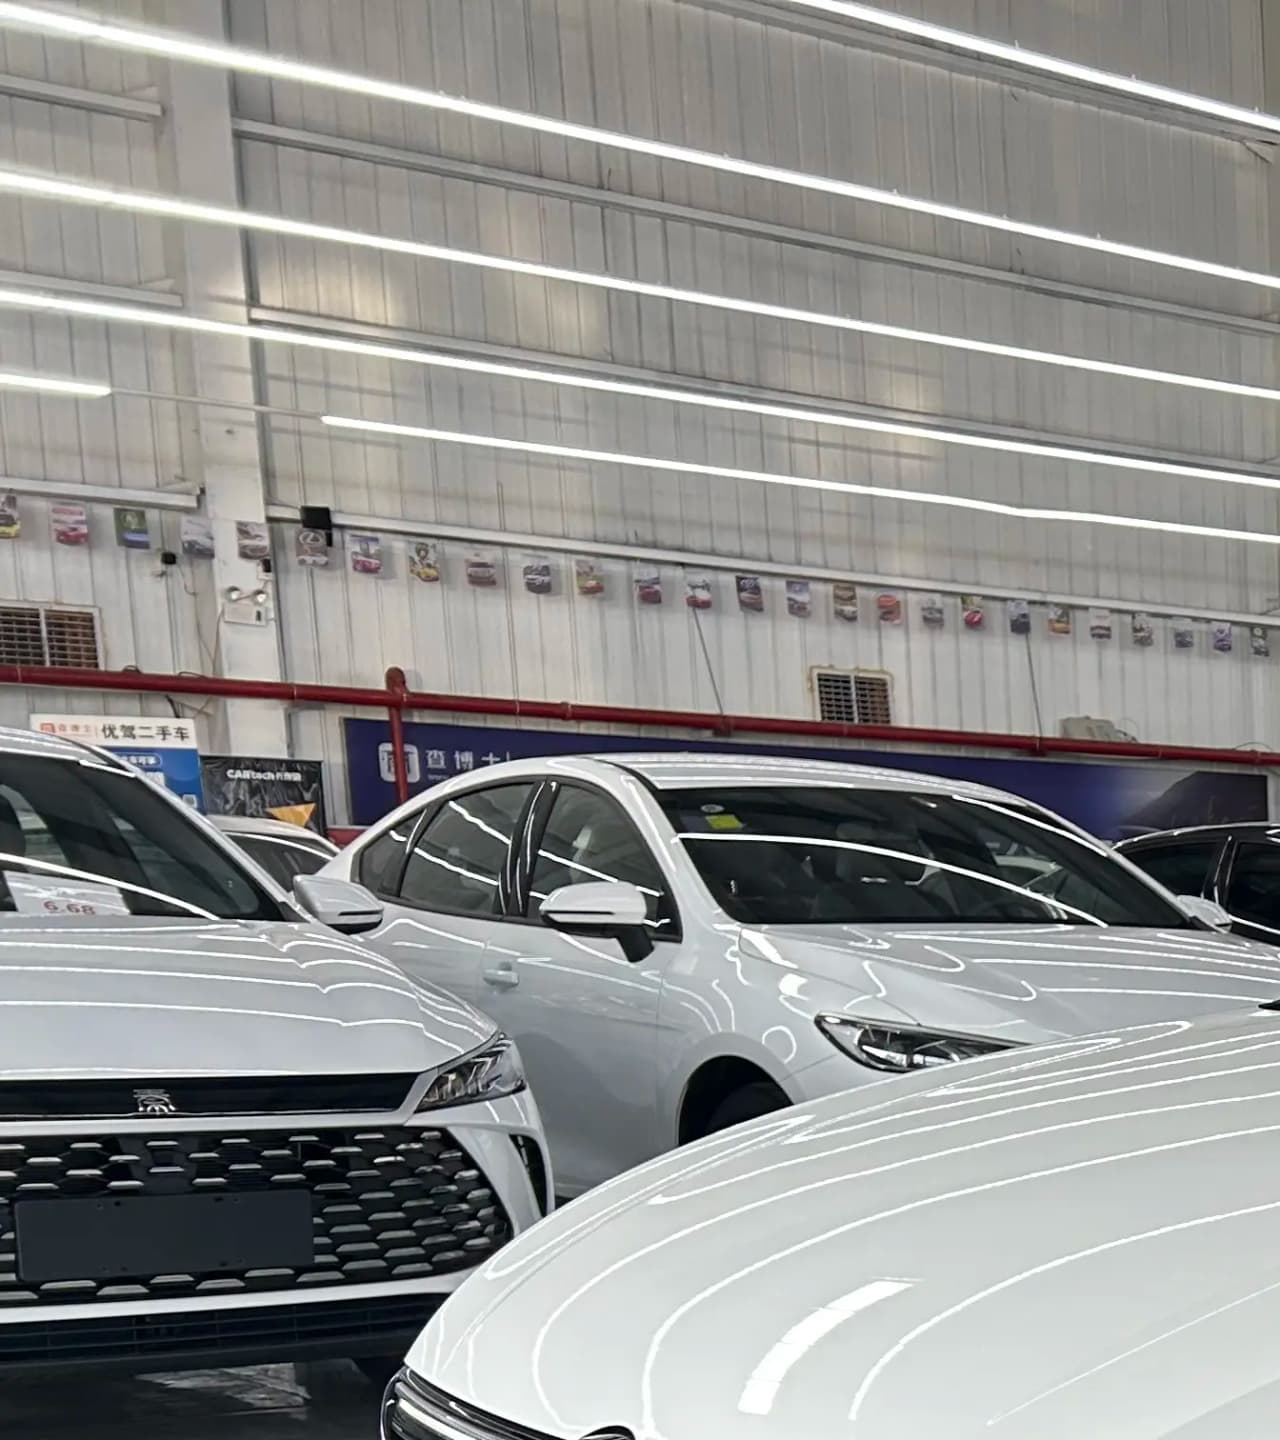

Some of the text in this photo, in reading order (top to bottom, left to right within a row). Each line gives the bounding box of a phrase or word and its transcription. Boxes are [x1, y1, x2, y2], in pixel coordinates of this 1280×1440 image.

[102, 723, 190, 741] 优驾二手车
